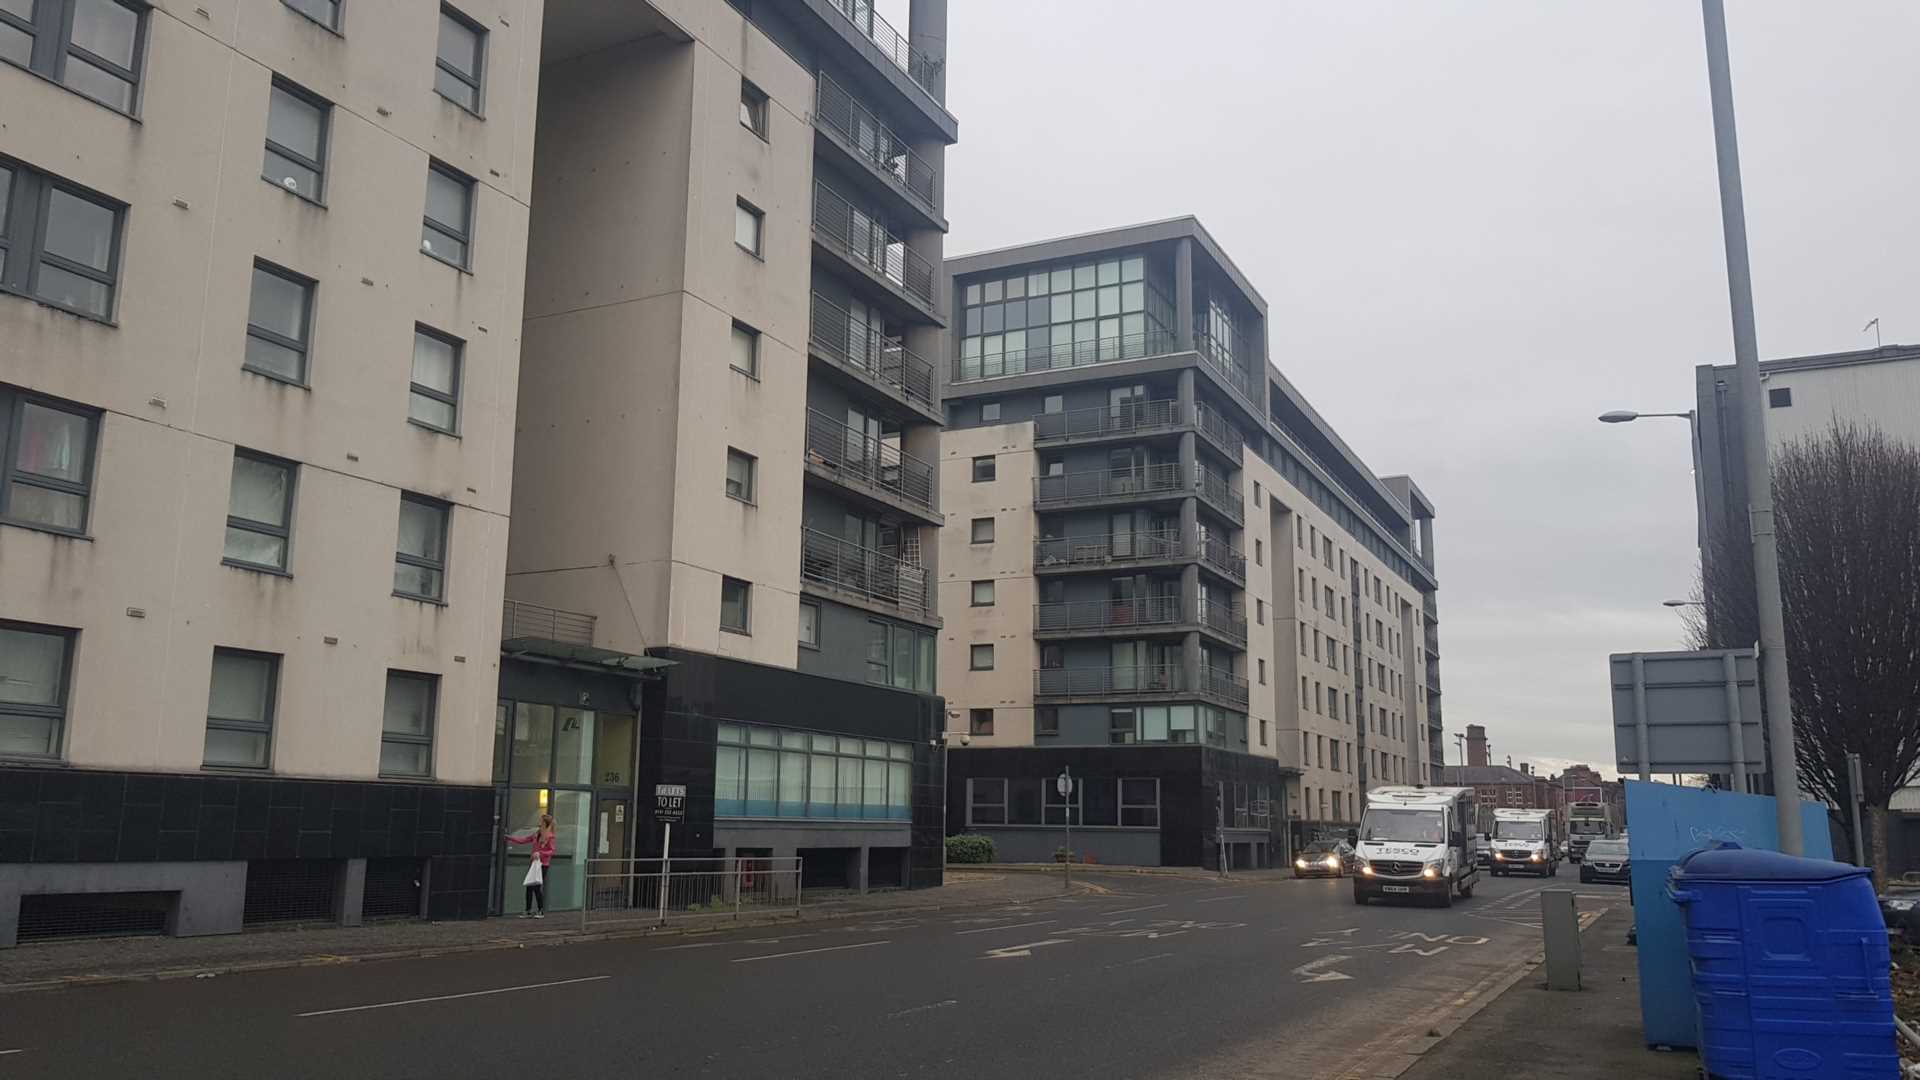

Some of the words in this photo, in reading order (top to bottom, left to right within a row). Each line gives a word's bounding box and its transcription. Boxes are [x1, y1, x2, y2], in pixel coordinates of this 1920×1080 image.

[657, 796, 668, 808] TO
[668, 797, 682, 808] LET
[1376, 847, 1420, 856] TESCO
